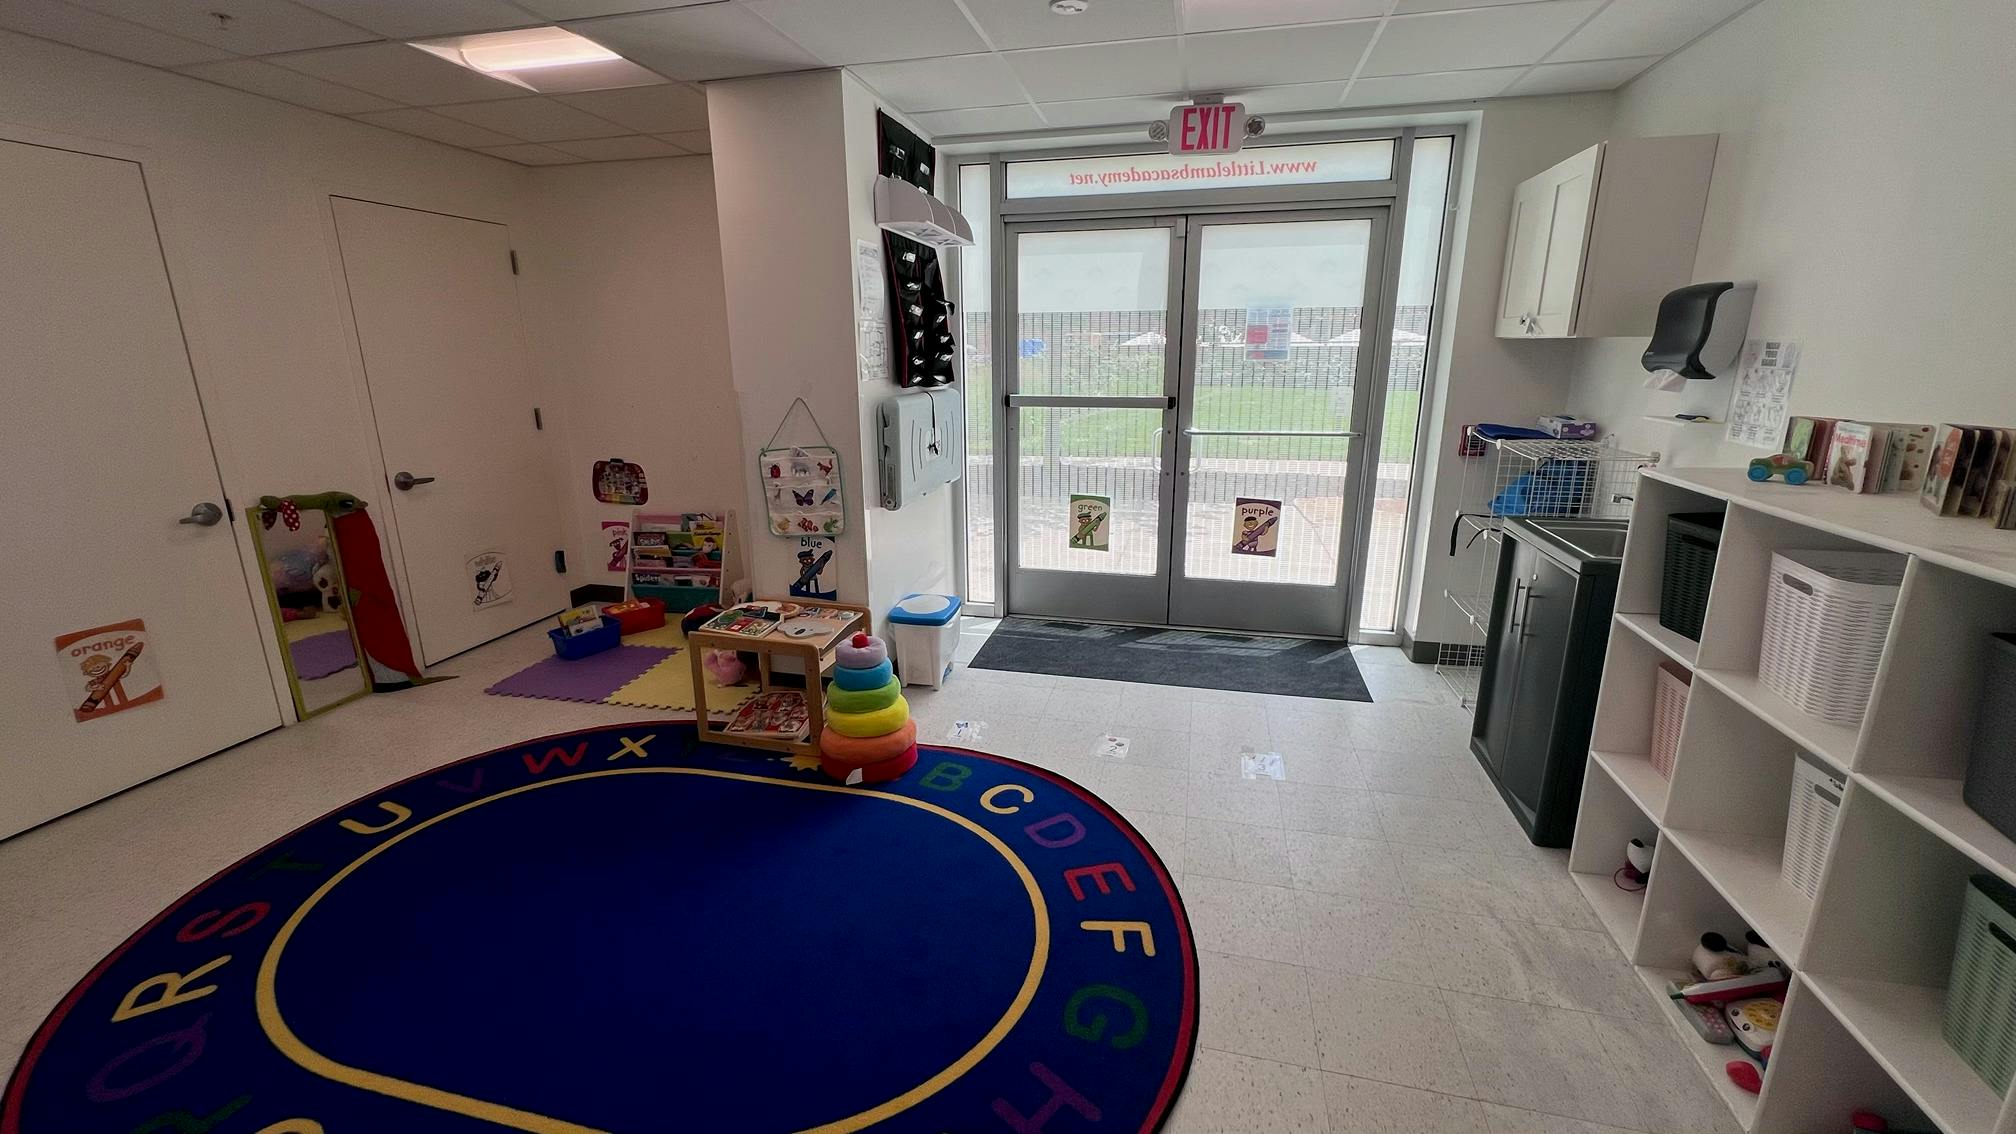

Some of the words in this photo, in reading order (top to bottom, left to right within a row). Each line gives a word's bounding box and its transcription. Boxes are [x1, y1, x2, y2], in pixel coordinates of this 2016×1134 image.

[1181, 105, 1236, 151] EXIT
[1077, 502, 1103, 513] green
[1241, 506, 1274, 518] purple
[800, 536, 823, 549] blue
[71, 634, 135, 657] orange
[522, 742, 589, 774] W
[1108, 744, 1118, 753] 2
[918, 761, 973, 792] B
[979, 784, 1035, 815] C
[338, 801, 413, 834] U
[1023, 812, 1087, 848] D
[1063, 861, 1137, 902] E
[176, 901, 270, 943] S
[1080, 920, 1157, 957] F
[111, 954, 233, 1023] R
[1064, 984, 1149, 1049] G
[86, 1011, 212, 1103] Q
